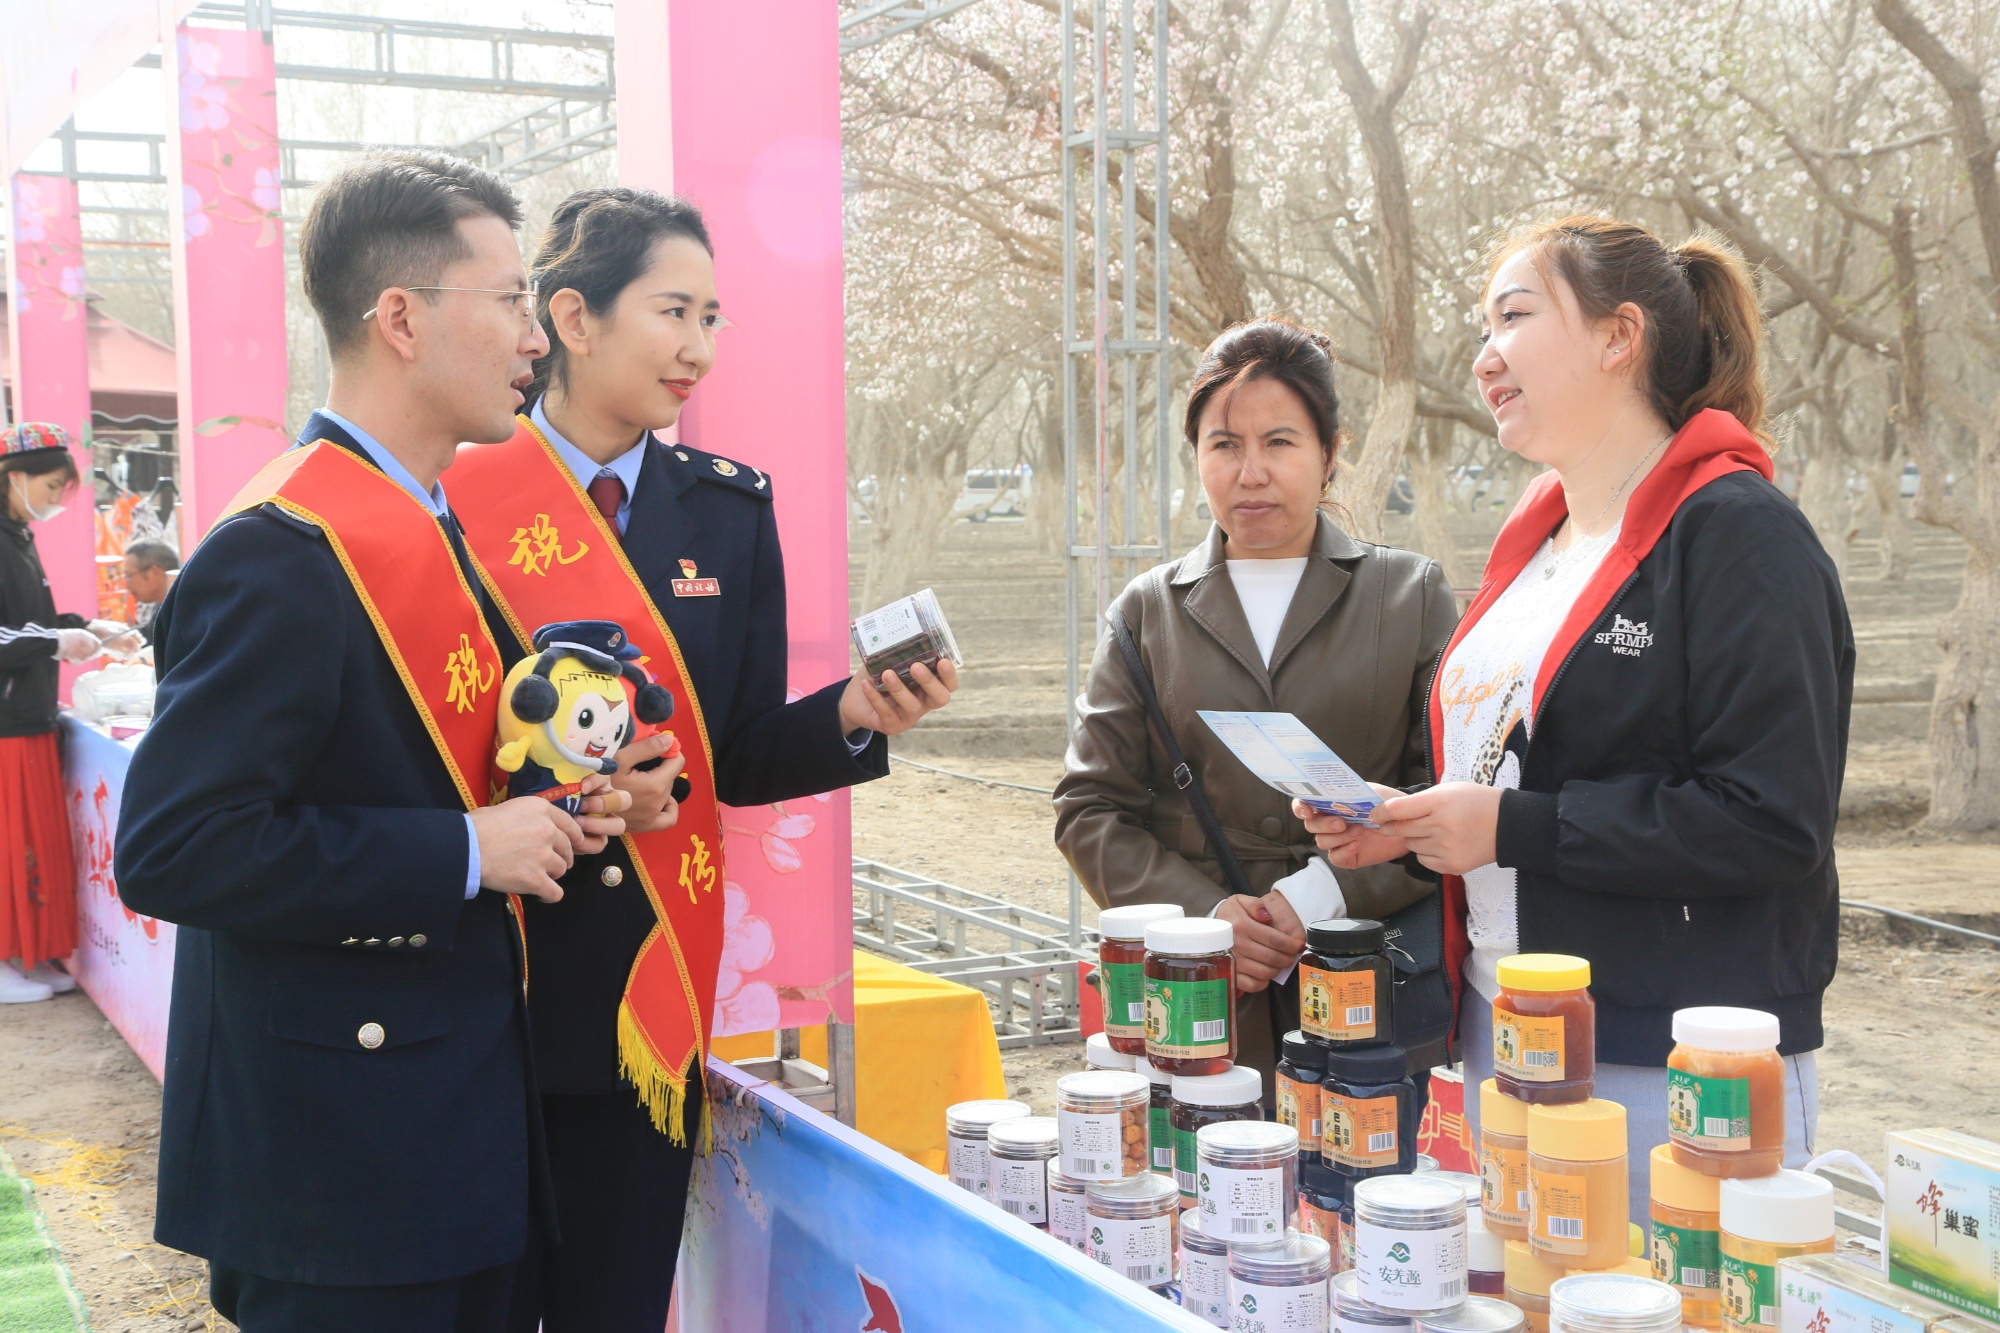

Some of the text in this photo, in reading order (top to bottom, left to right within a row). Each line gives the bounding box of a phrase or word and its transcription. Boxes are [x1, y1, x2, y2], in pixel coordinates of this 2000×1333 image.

[508, 514, 589, 577] 税
[676, 582, 715, 593] 中国税务
[1612, 645, 1641, 657] WEAR
[443, 633, 496, 714] 税
